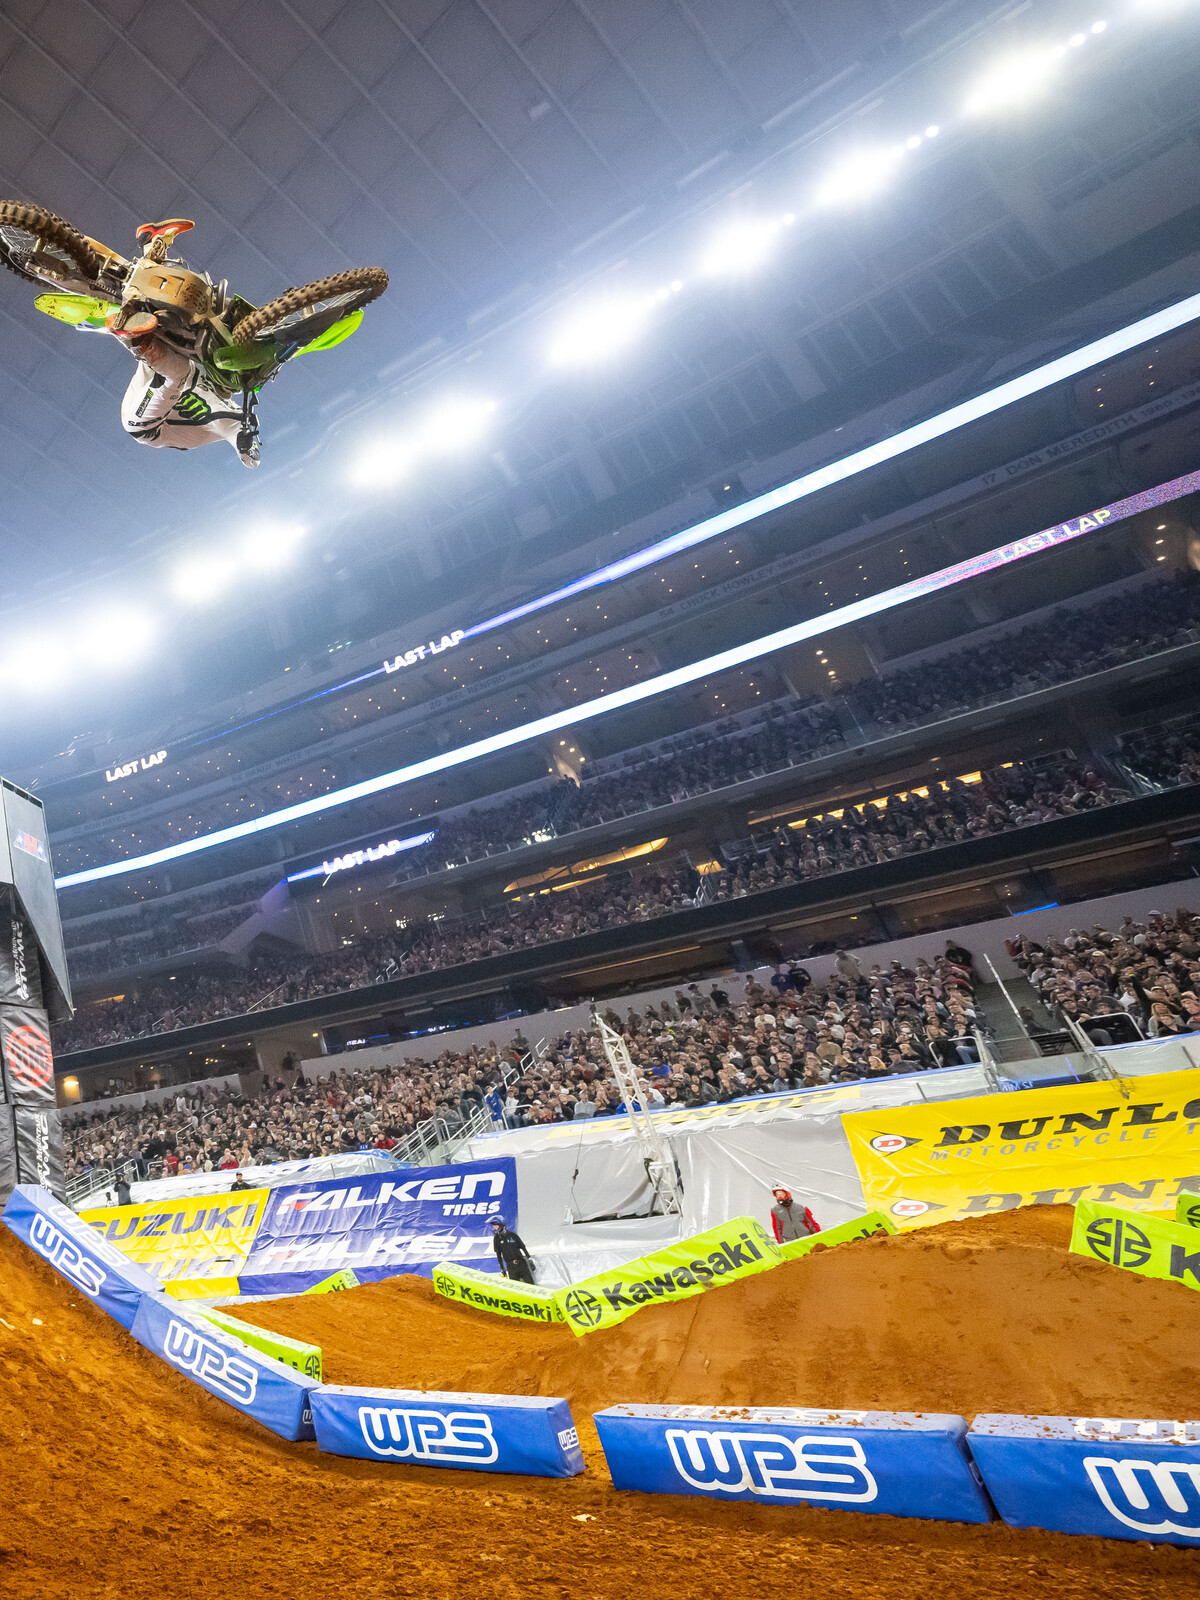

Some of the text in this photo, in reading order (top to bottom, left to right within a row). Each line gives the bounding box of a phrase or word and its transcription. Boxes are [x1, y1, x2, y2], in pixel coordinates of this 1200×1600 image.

[1006, 454, 1042, 477] DON
[1047, 414, 1137, 460] MEREDITH
[999, 509, 1111, 563] LAST LAP
[659, 606, 674, 619] 54
[678, 588, 719, 610] CHUCK
[721, 566, 773, 593] HOWLEY
[383, 629, 465, 674] LAST LAP
[428, 699, 442, 709] 20
[445, 690, 465, 703] MEL
[466, 674, 507, 694] RENFRO
[105, 750, 168, 782] LAST LAP
[12, 829, 48, 860] AMA
[323, 839, 401, 874] LAST LAP
[34, 1114, 43, 1161] MOUNTAIN
[929, 1127, 1160, 1162] MOTORCYCLE
[276, 1171, 507, 1215] FALKEN
[442, 1201, 500, 1217] TIRES
[30, 1212, 107, 1297] WPS
[48, 1205, 131, 1267] WPS
[258, 1234, 495, 1266] FALKEN
[602, 1232, 764, 1311] Kawasaki
[459, 1285, 552, 1321] Kawasaki
[164, 1319, 259, 1406] WPS
[358, 1407, 499, 1465] WPS
[557, 1427, 579, 1450] WPS
[665, 1429, 877, 1504] WPS
